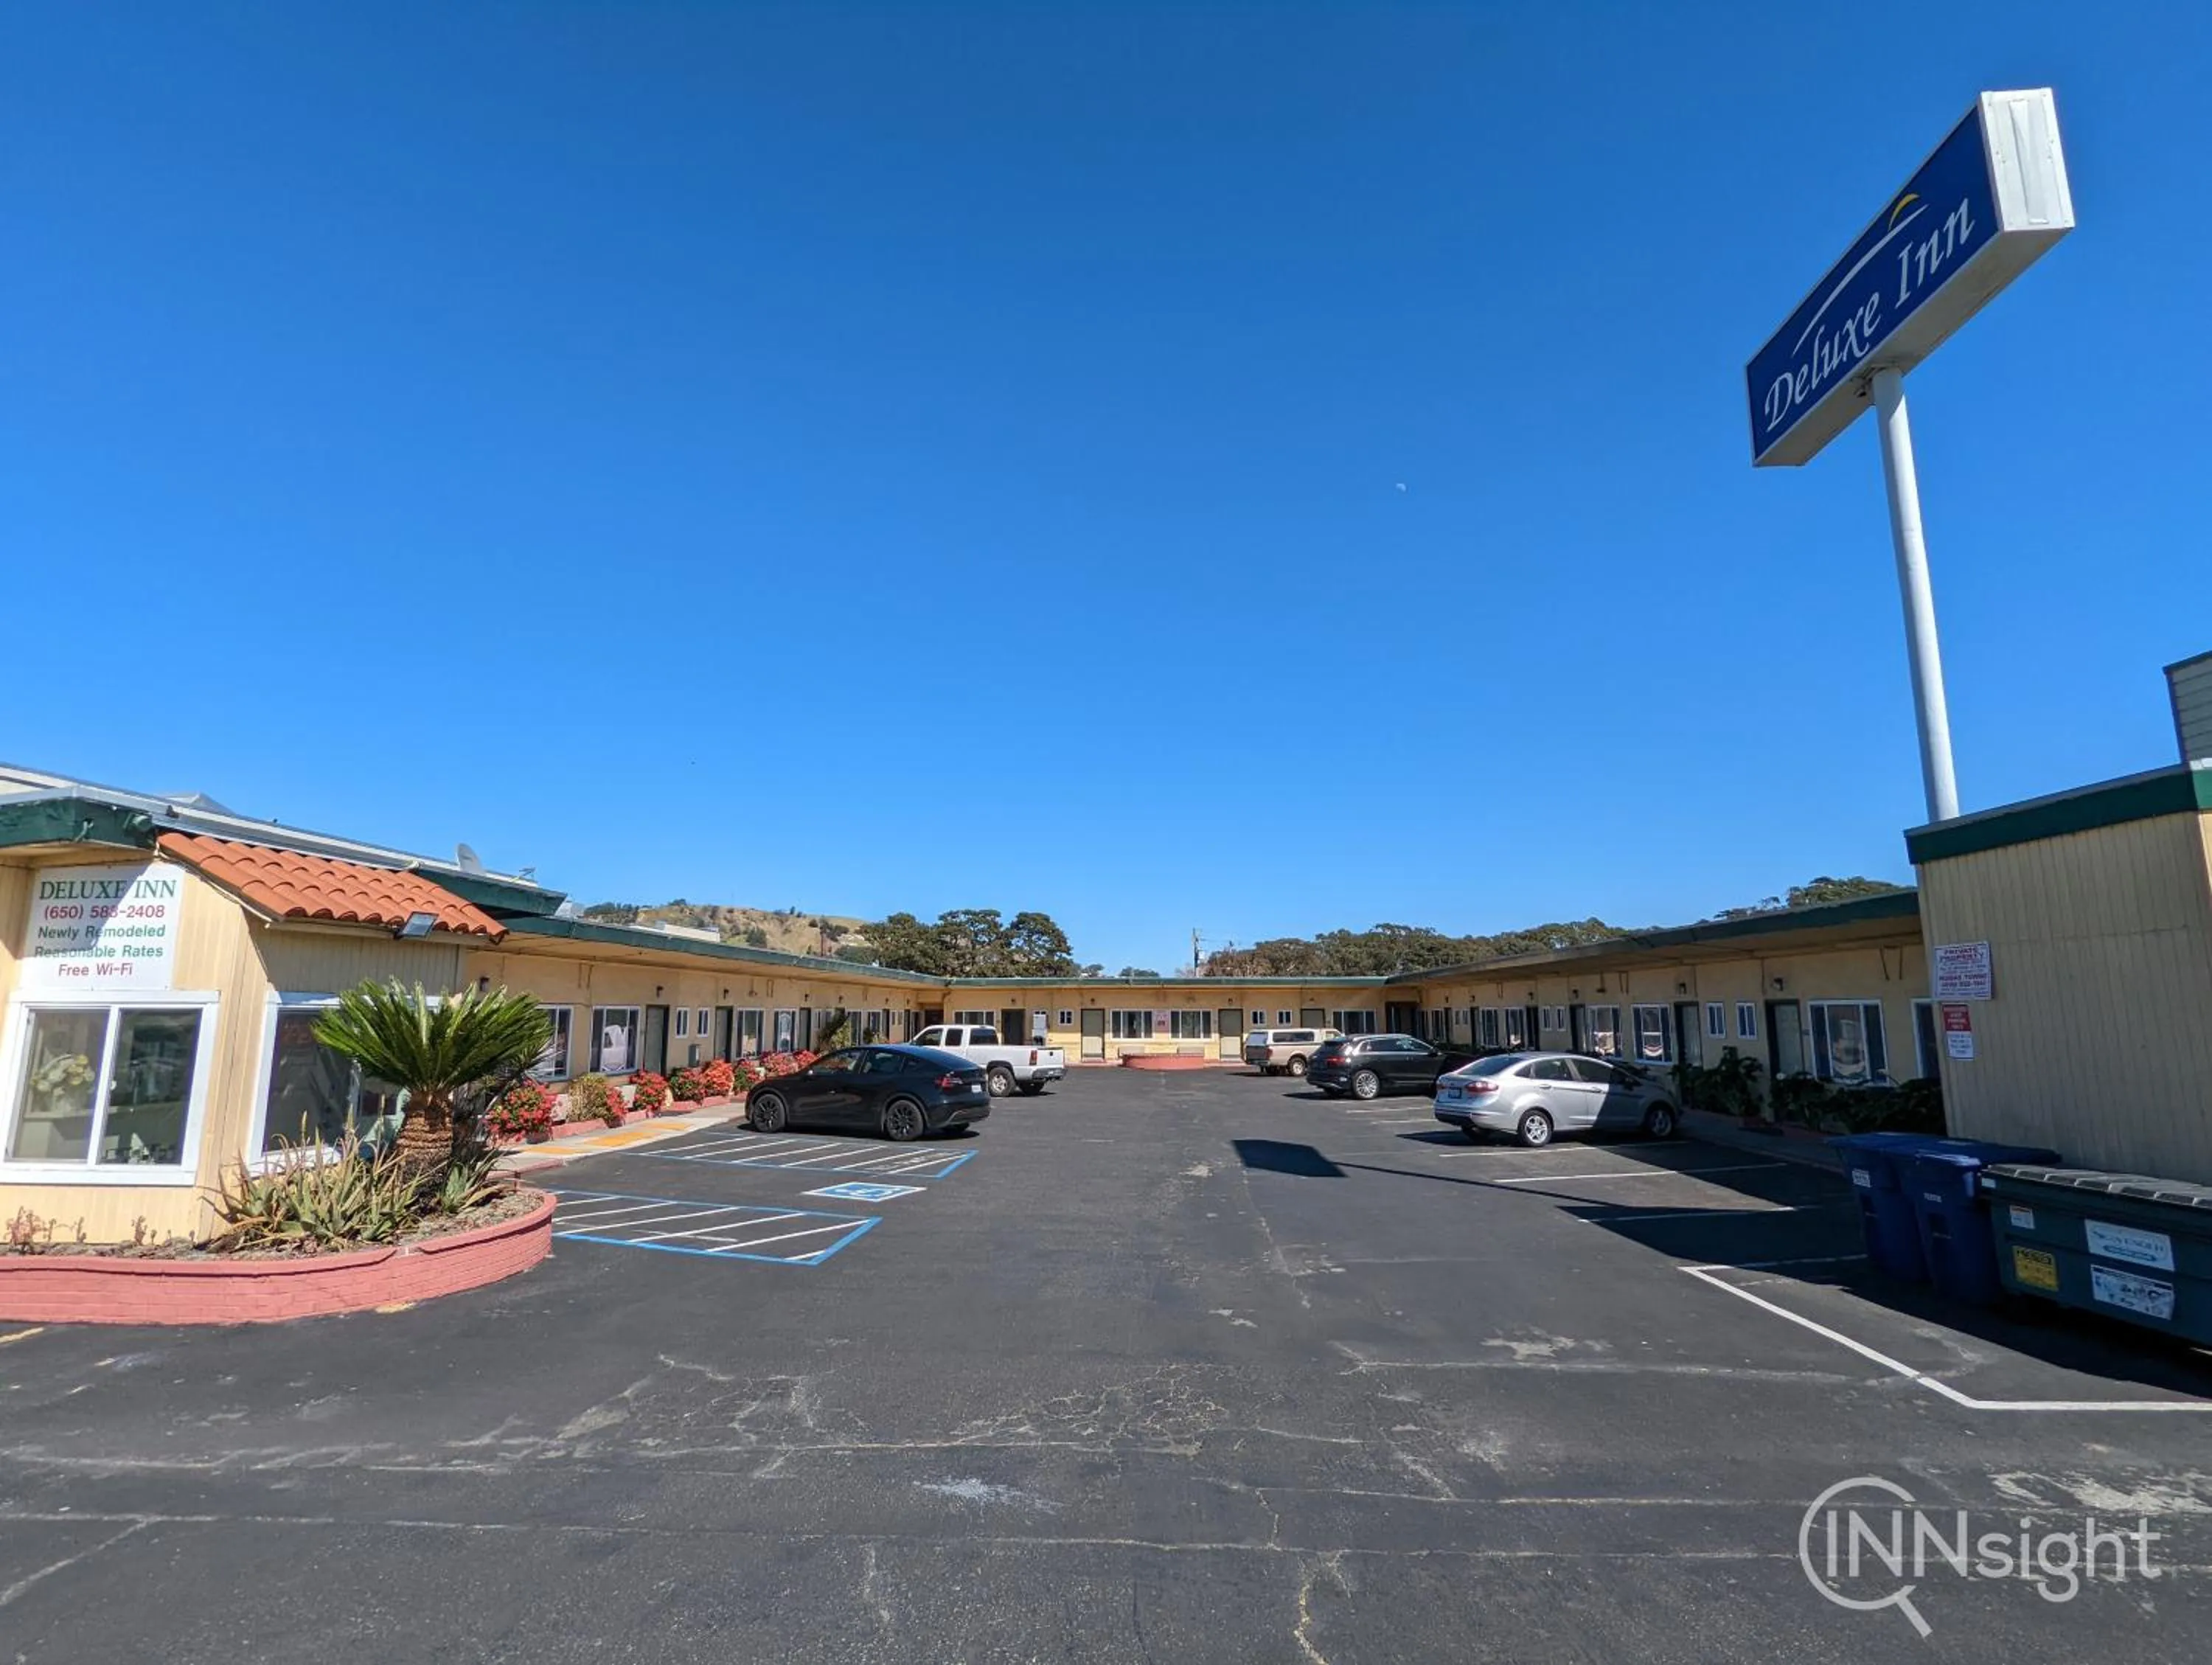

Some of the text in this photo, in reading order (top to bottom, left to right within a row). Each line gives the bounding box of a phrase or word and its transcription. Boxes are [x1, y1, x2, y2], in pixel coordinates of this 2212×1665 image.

[1764, 198, 1976, 433] Deluxe Inn
[39, 880, 177, 900] DELUXE INN
[44, 905, 83, 920] (650)
[38, 925, 166, 941] Newly Remodeled
[35, 945, 164, 958] Reasonable Rates
[58, 963, 133, 976] Free Wi-Fi
